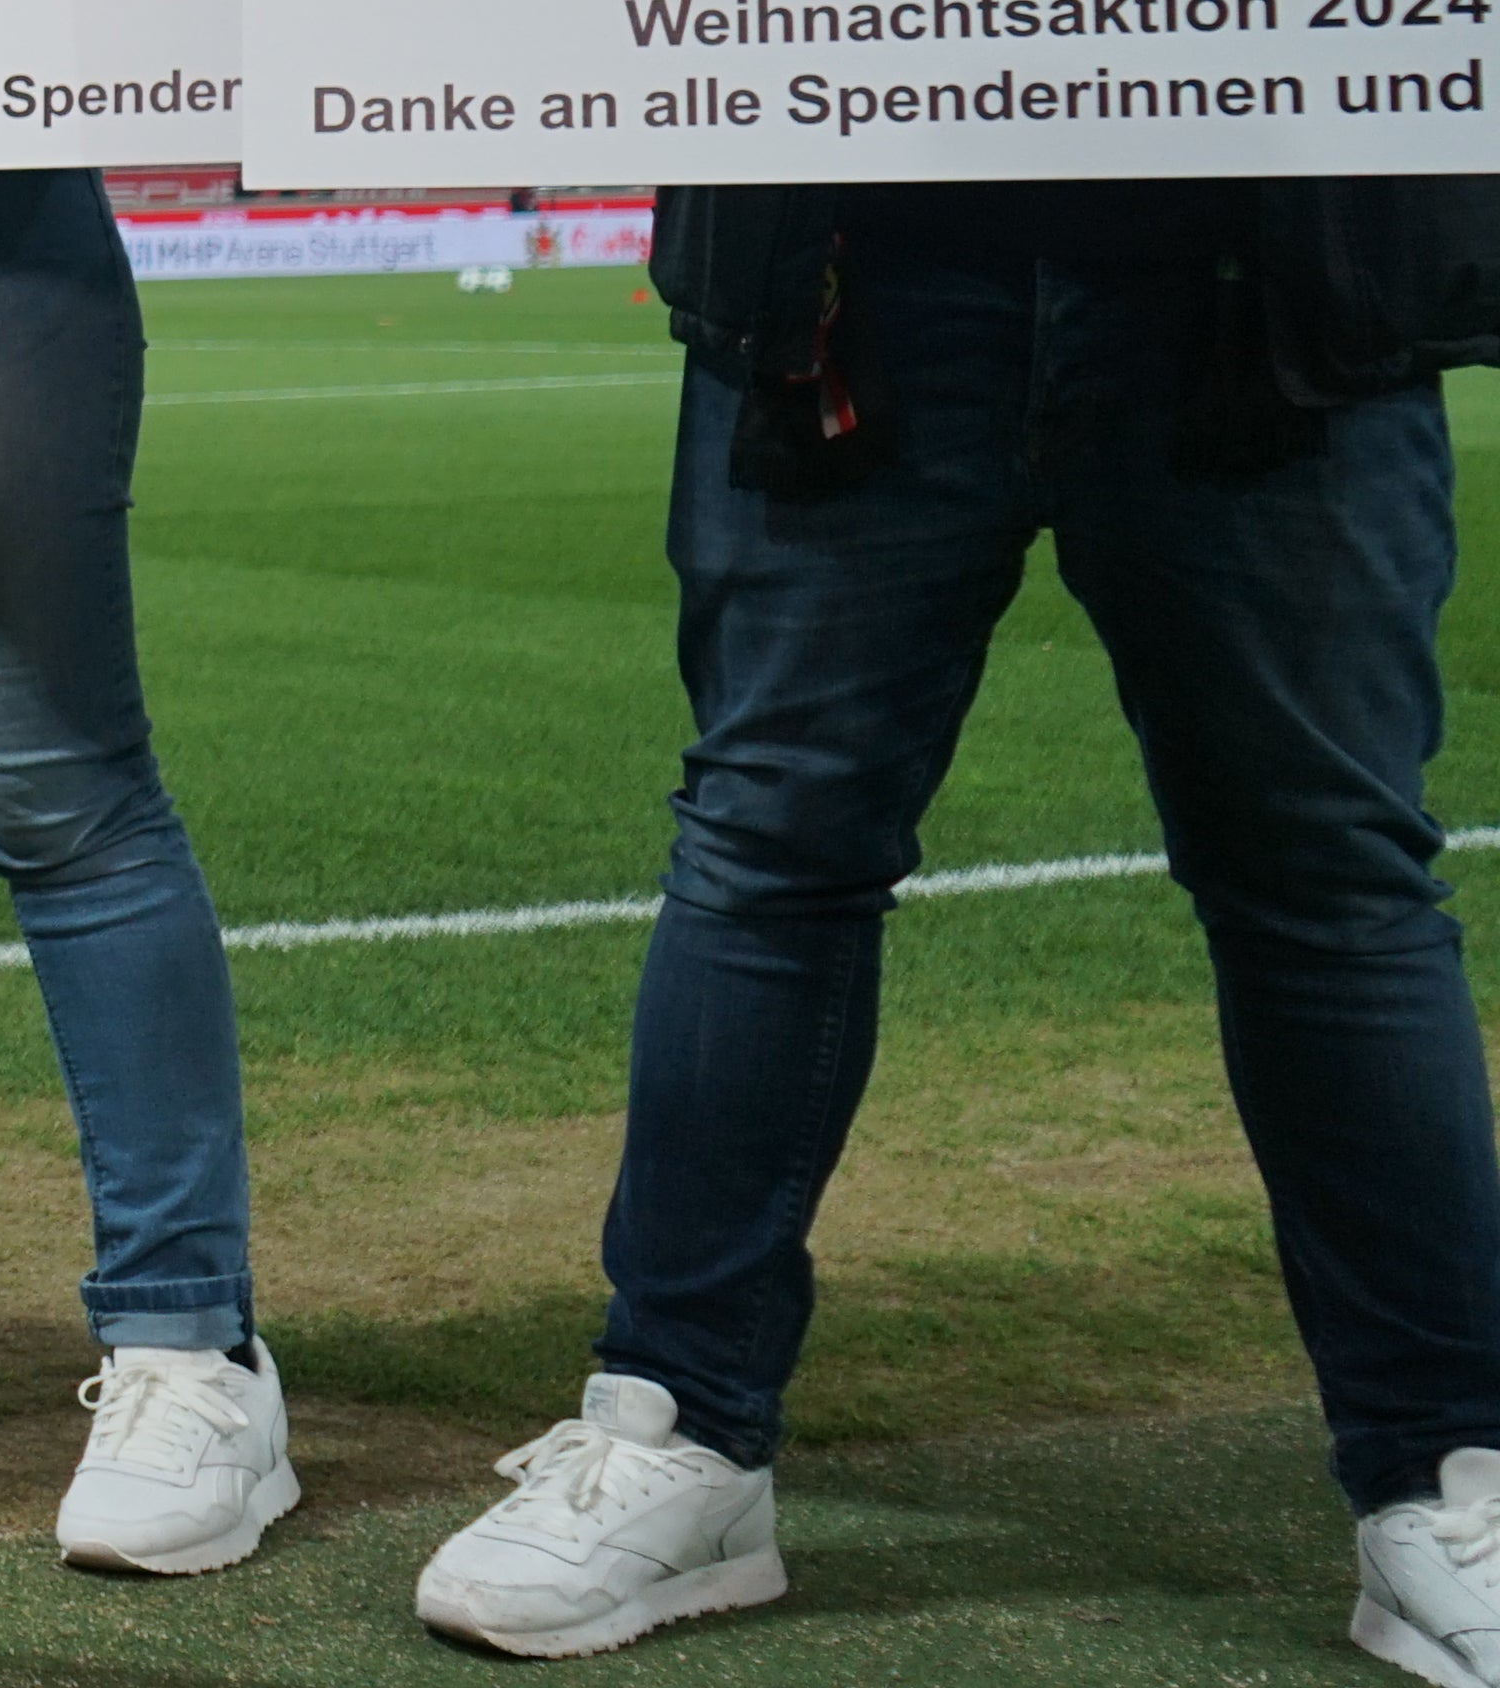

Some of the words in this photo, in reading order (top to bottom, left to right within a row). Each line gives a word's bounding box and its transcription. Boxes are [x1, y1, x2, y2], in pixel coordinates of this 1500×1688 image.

[312, 84, 516, 136] Danke
[539, 90, 618, 131] an
[643, 78, 763, 130] alle
[786, 66, 1305, 137] Spenderinnen
[1335, 59, 1485, 116] und
